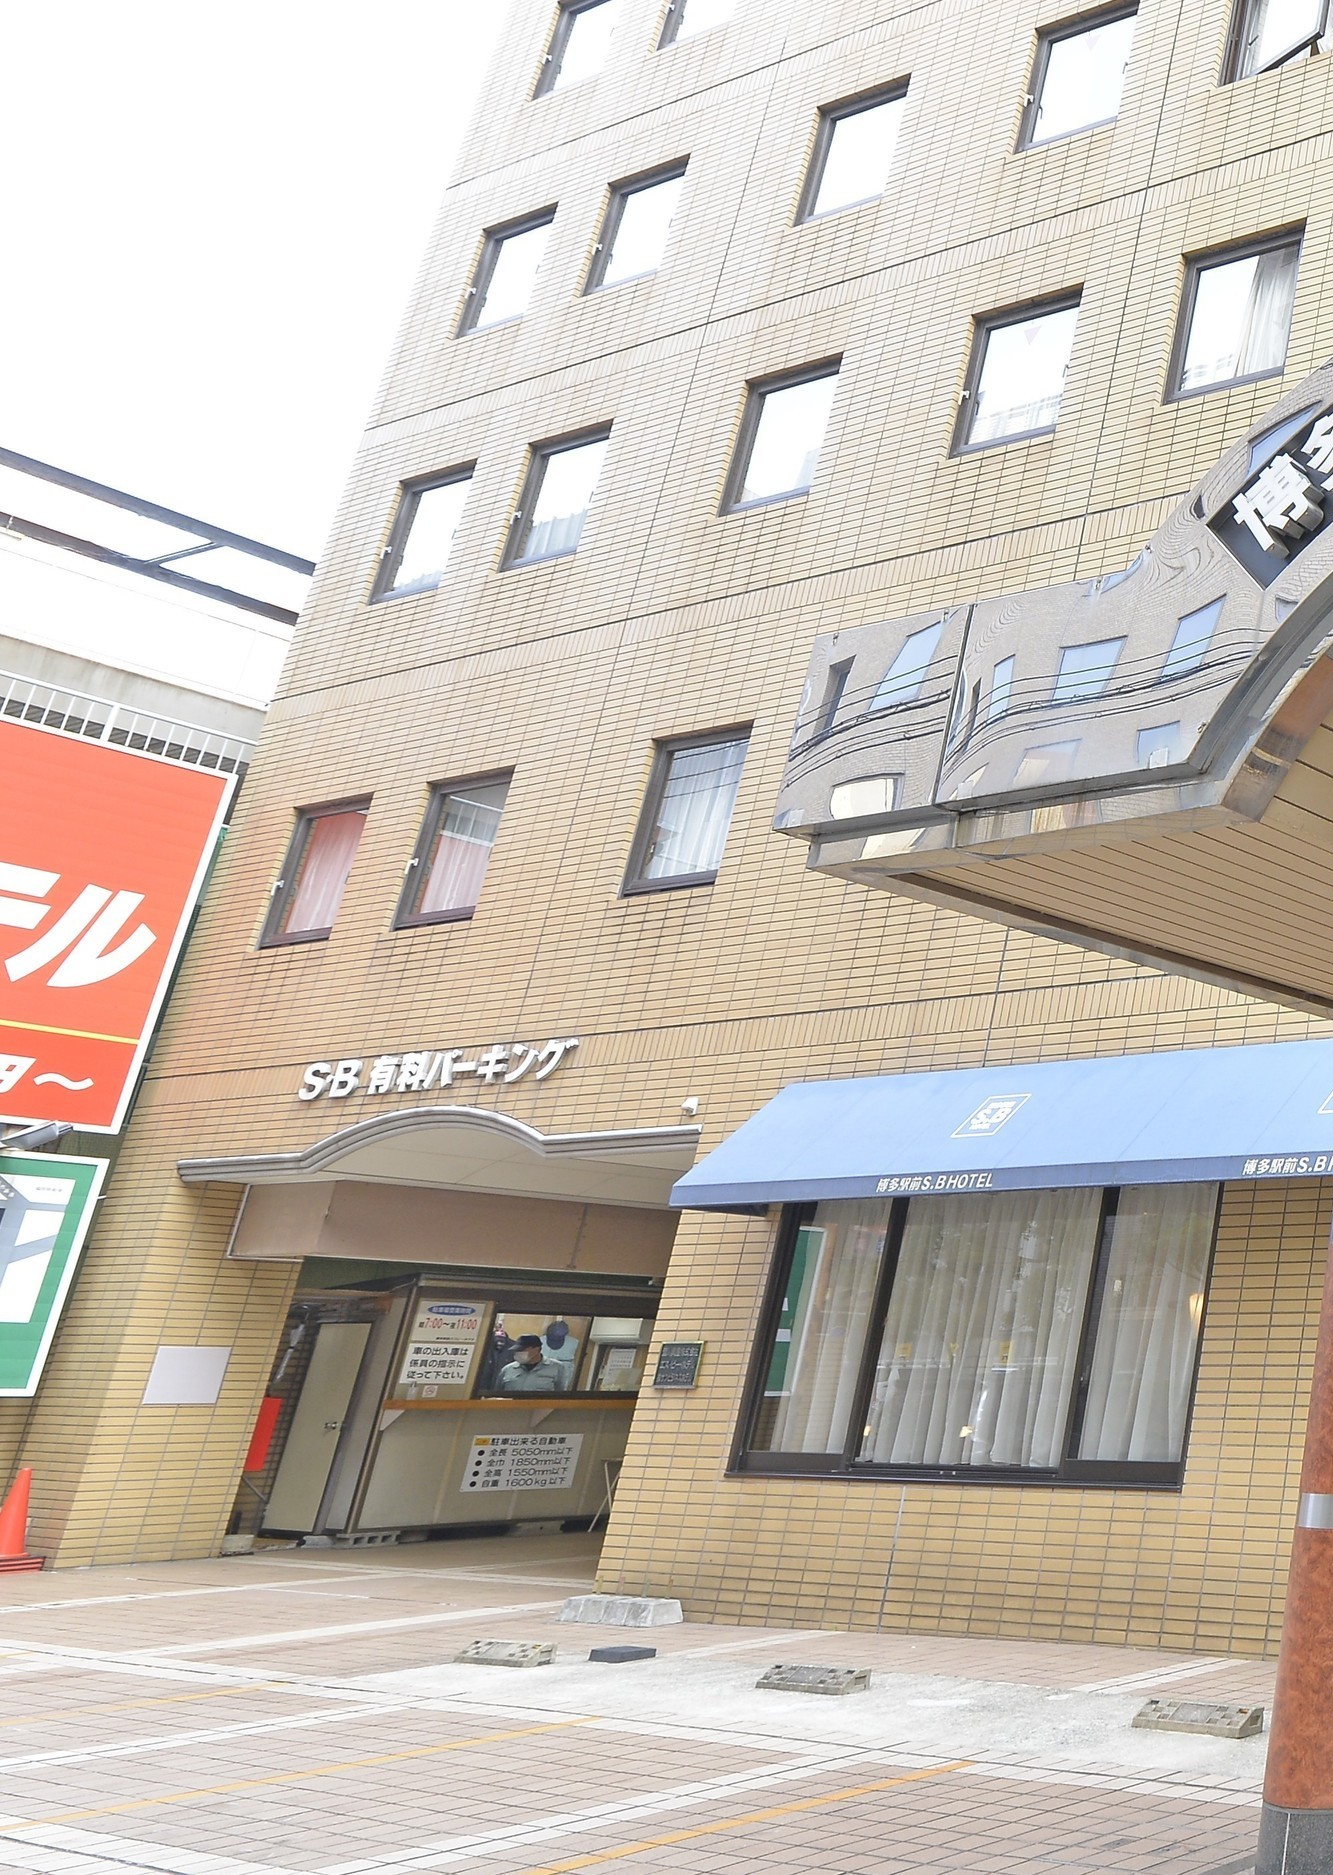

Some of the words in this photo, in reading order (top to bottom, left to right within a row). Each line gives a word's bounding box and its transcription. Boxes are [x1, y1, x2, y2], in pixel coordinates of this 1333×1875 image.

[366, 1038, 580, 1095] 有料パーキング
[947, 1173, 993, 1189] HOTEL
[412, 1346, 469, 1356] 車の出入庫は
[409, 1359, 466, 1368] 係員の指示に
[406, 1370, 464, 1380] 従って下さい。
[490, 1437, 567, 1446] 駐車出来る自動車
[489, 1448, 508, 1457] 全長
[511, 1447, 573, 1456] 5050mm以下
[511, 1457, 571, 1466] 1850mm以下
[483, 1469, 503, 1478] 全高
[508, 1467, 568, 1477] 1550mm以下
